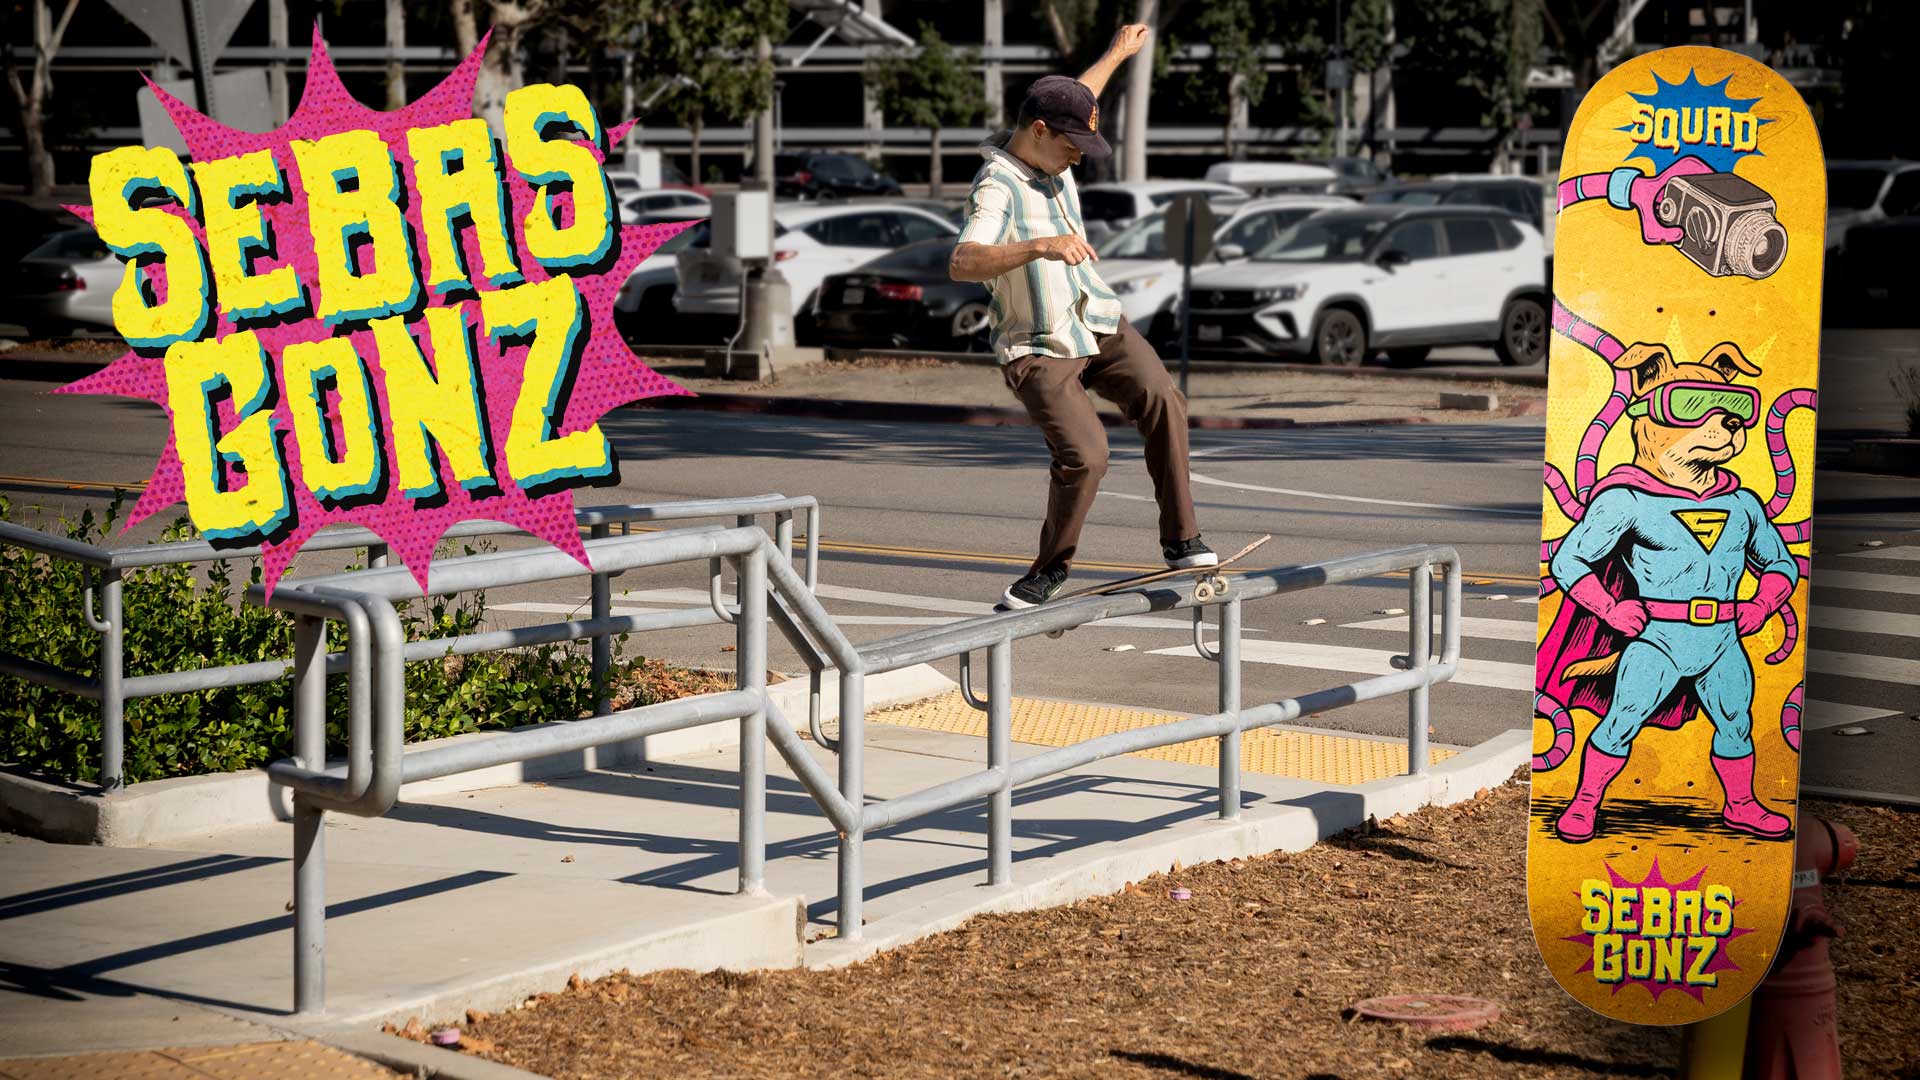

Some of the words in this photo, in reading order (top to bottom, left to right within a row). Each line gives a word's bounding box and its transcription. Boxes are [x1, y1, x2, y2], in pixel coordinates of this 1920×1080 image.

[1630, 103, 1759, 155] SQUAD
[1580, 879, 1735, 938] SEBAS
[1593, 933, 1718, 987] GONZ
